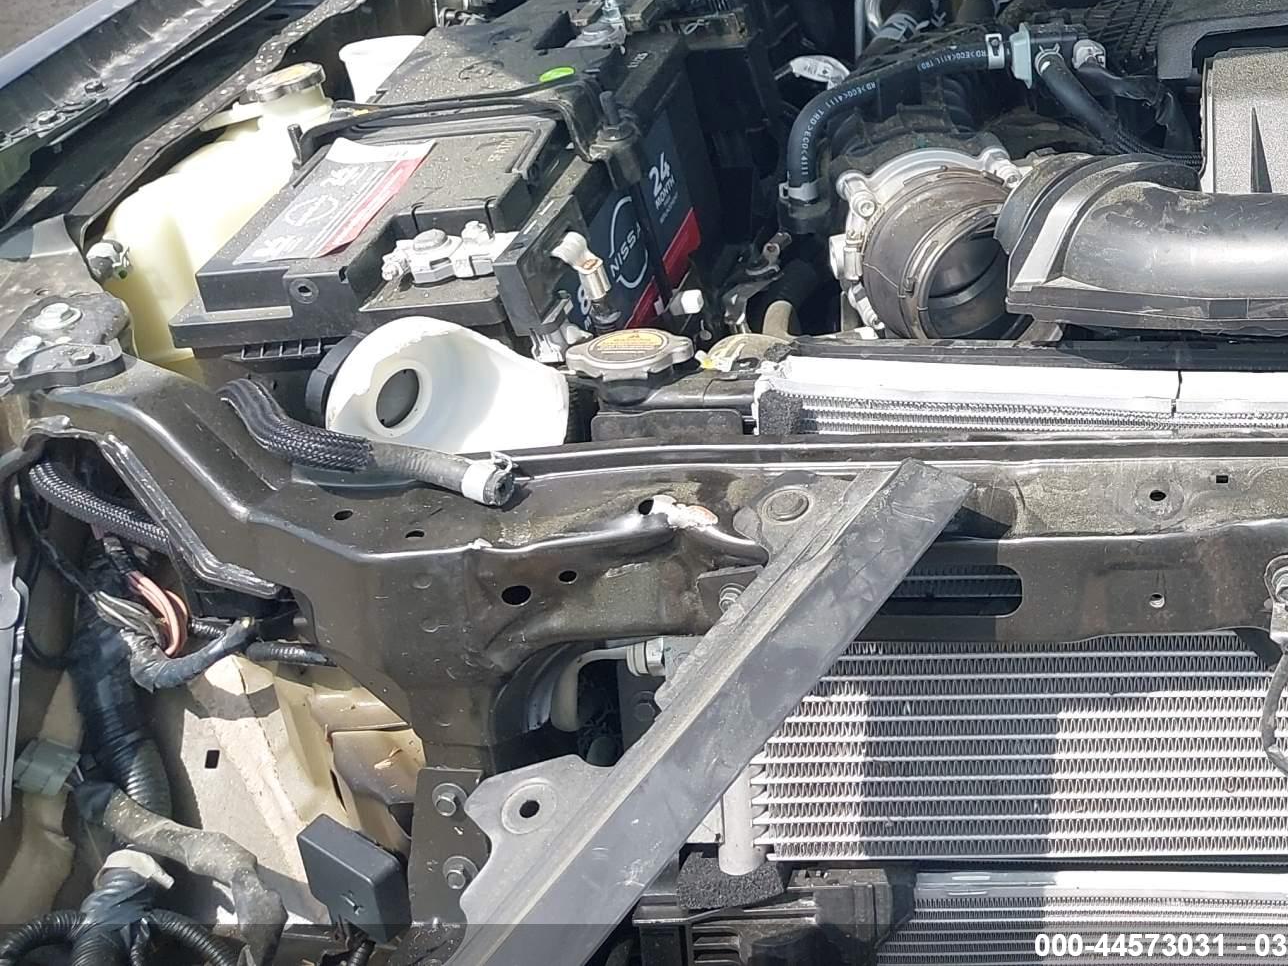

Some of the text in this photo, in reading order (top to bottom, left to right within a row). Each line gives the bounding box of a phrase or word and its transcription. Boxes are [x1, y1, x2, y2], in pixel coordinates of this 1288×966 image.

[649, 151, 671, 197] 24
[655, 175, 676, 211] MONTH
[609, 221, 642, 278] NISSA
